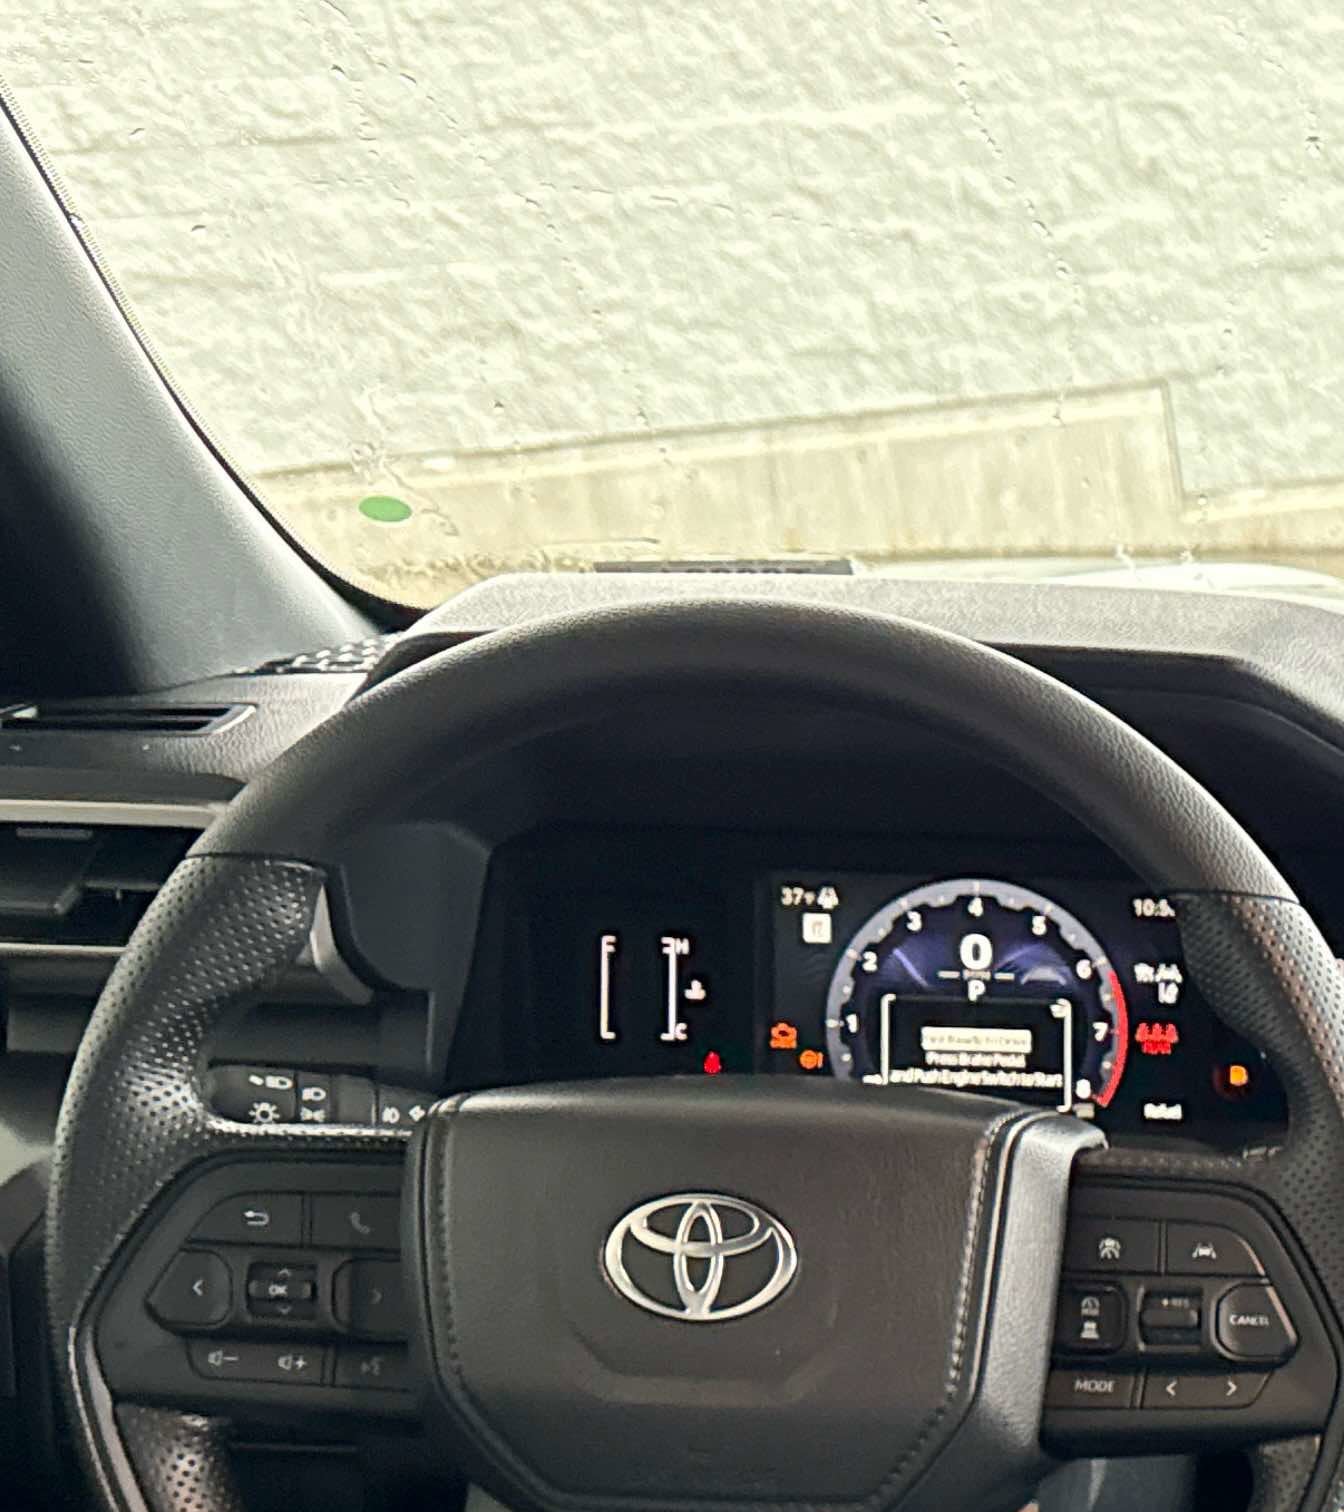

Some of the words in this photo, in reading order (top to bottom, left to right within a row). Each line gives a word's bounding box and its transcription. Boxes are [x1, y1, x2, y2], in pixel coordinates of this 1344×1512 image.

[968, 897, 983, 917] 4
[906, 911, 922, 931] 3
[861, 951, 878, 972] 2
[959, 933, 993, 971] 0
[1075, 959, 1091, 979] 6
[968, 980, 986, 1001] P
[1075, 1379, 1116, 1393] MODE
